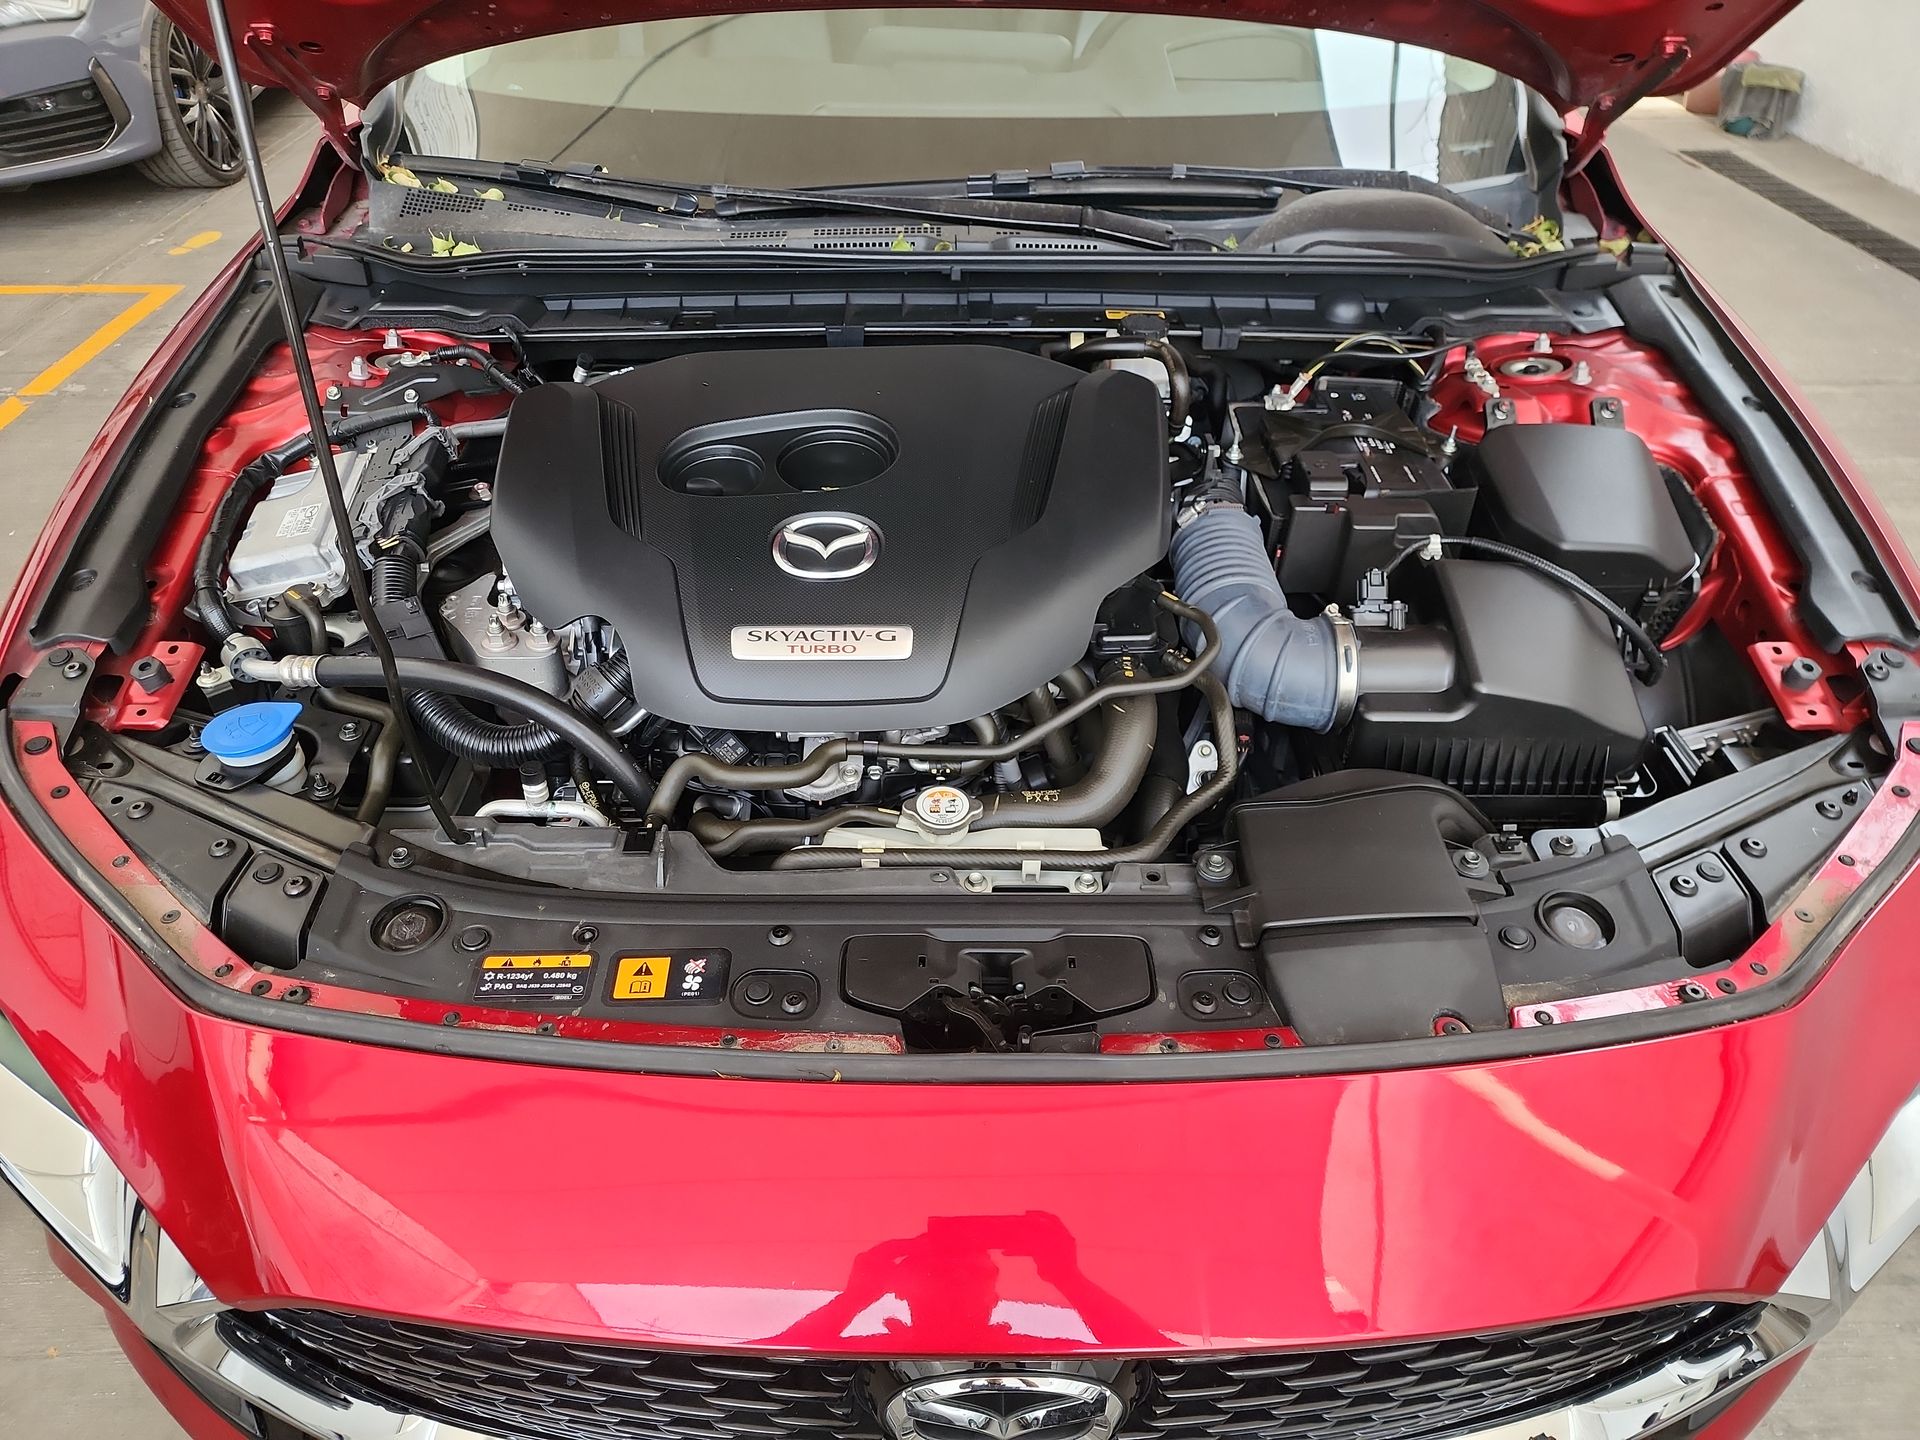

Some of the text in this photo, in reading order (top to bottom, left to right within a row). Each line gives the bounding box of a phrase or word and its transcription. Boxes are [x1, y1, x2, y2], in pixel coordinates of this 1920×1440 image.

[747, 630, 897, 642] SKYACTIV-G
[787, 644, 857, 654] TURBO
[497, 972, 534, 980] R-1234yf
[566, 972, 578, 980] kg
